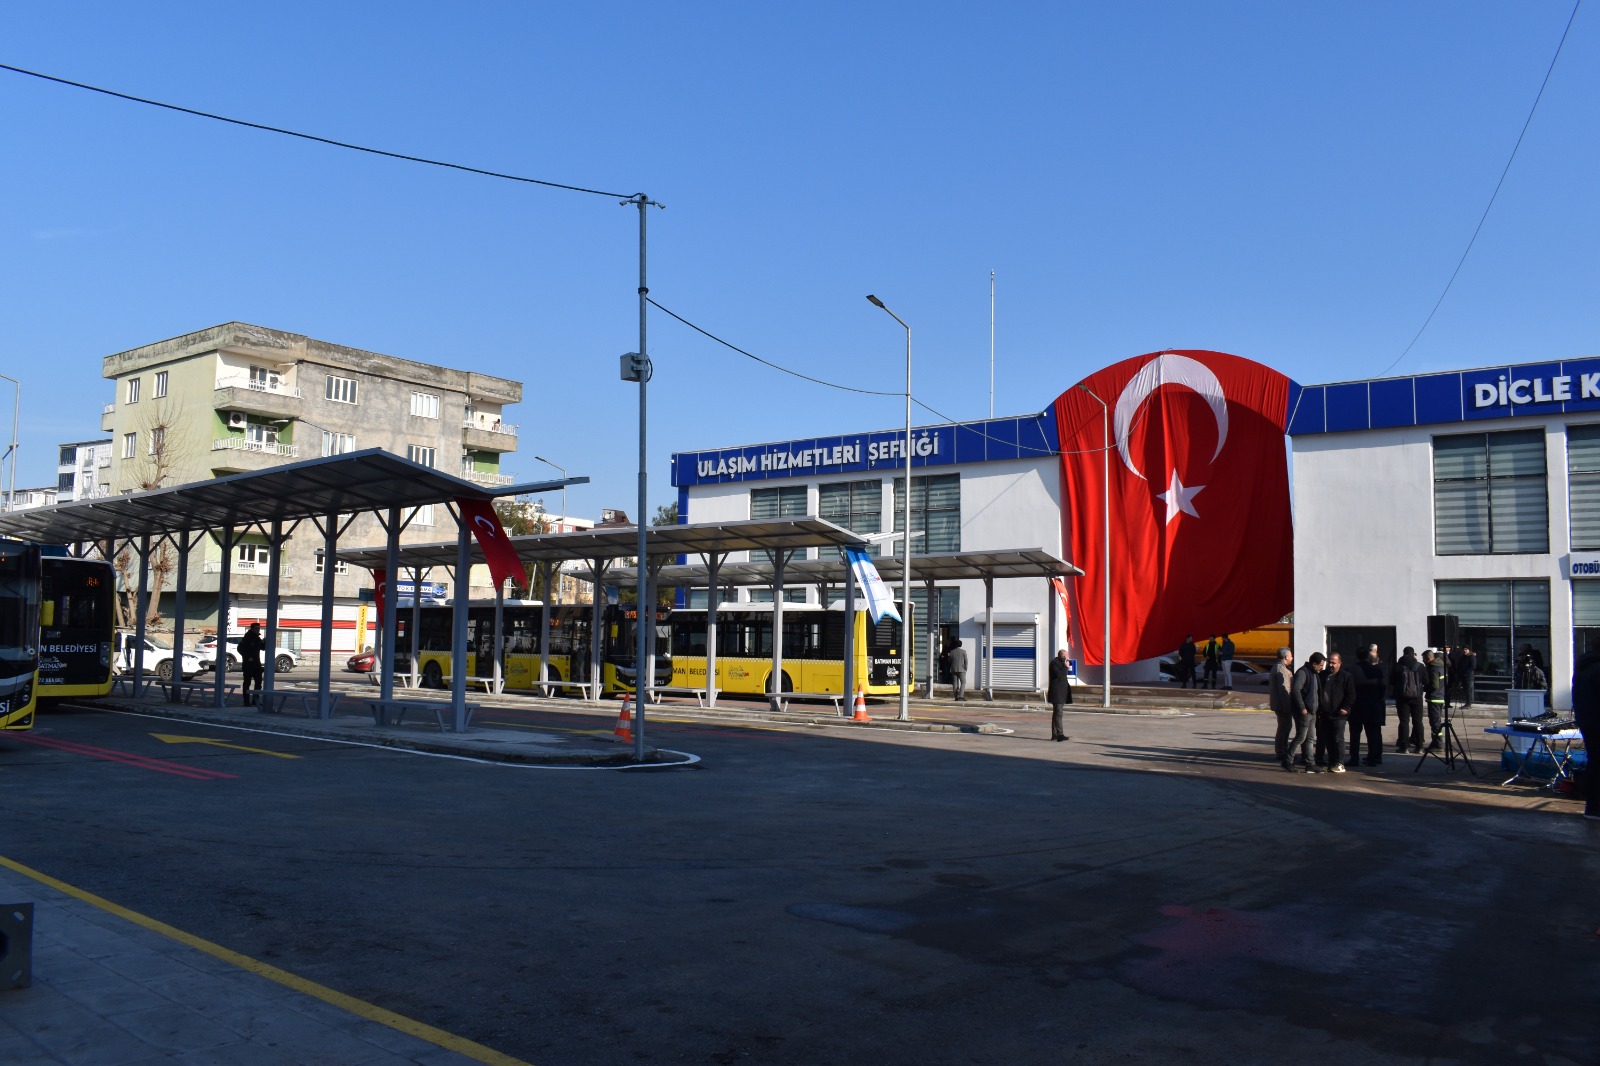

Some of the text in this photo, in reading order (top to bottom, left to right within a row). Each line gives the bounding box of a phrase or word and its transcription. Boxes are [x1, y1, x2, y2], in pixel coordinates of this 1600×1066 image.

[1474, 374, 1572, 408] DİCLE
[697, 431, 939, 480] ULAŞIM HİZMETLERİ ŞEFLİĞİ
[1572, 560, 1600, 574] OTOBÜ
[49, 643, 97, 653] BELEDİYESİ
[689, 667, 720, 675] BELEDSİ
